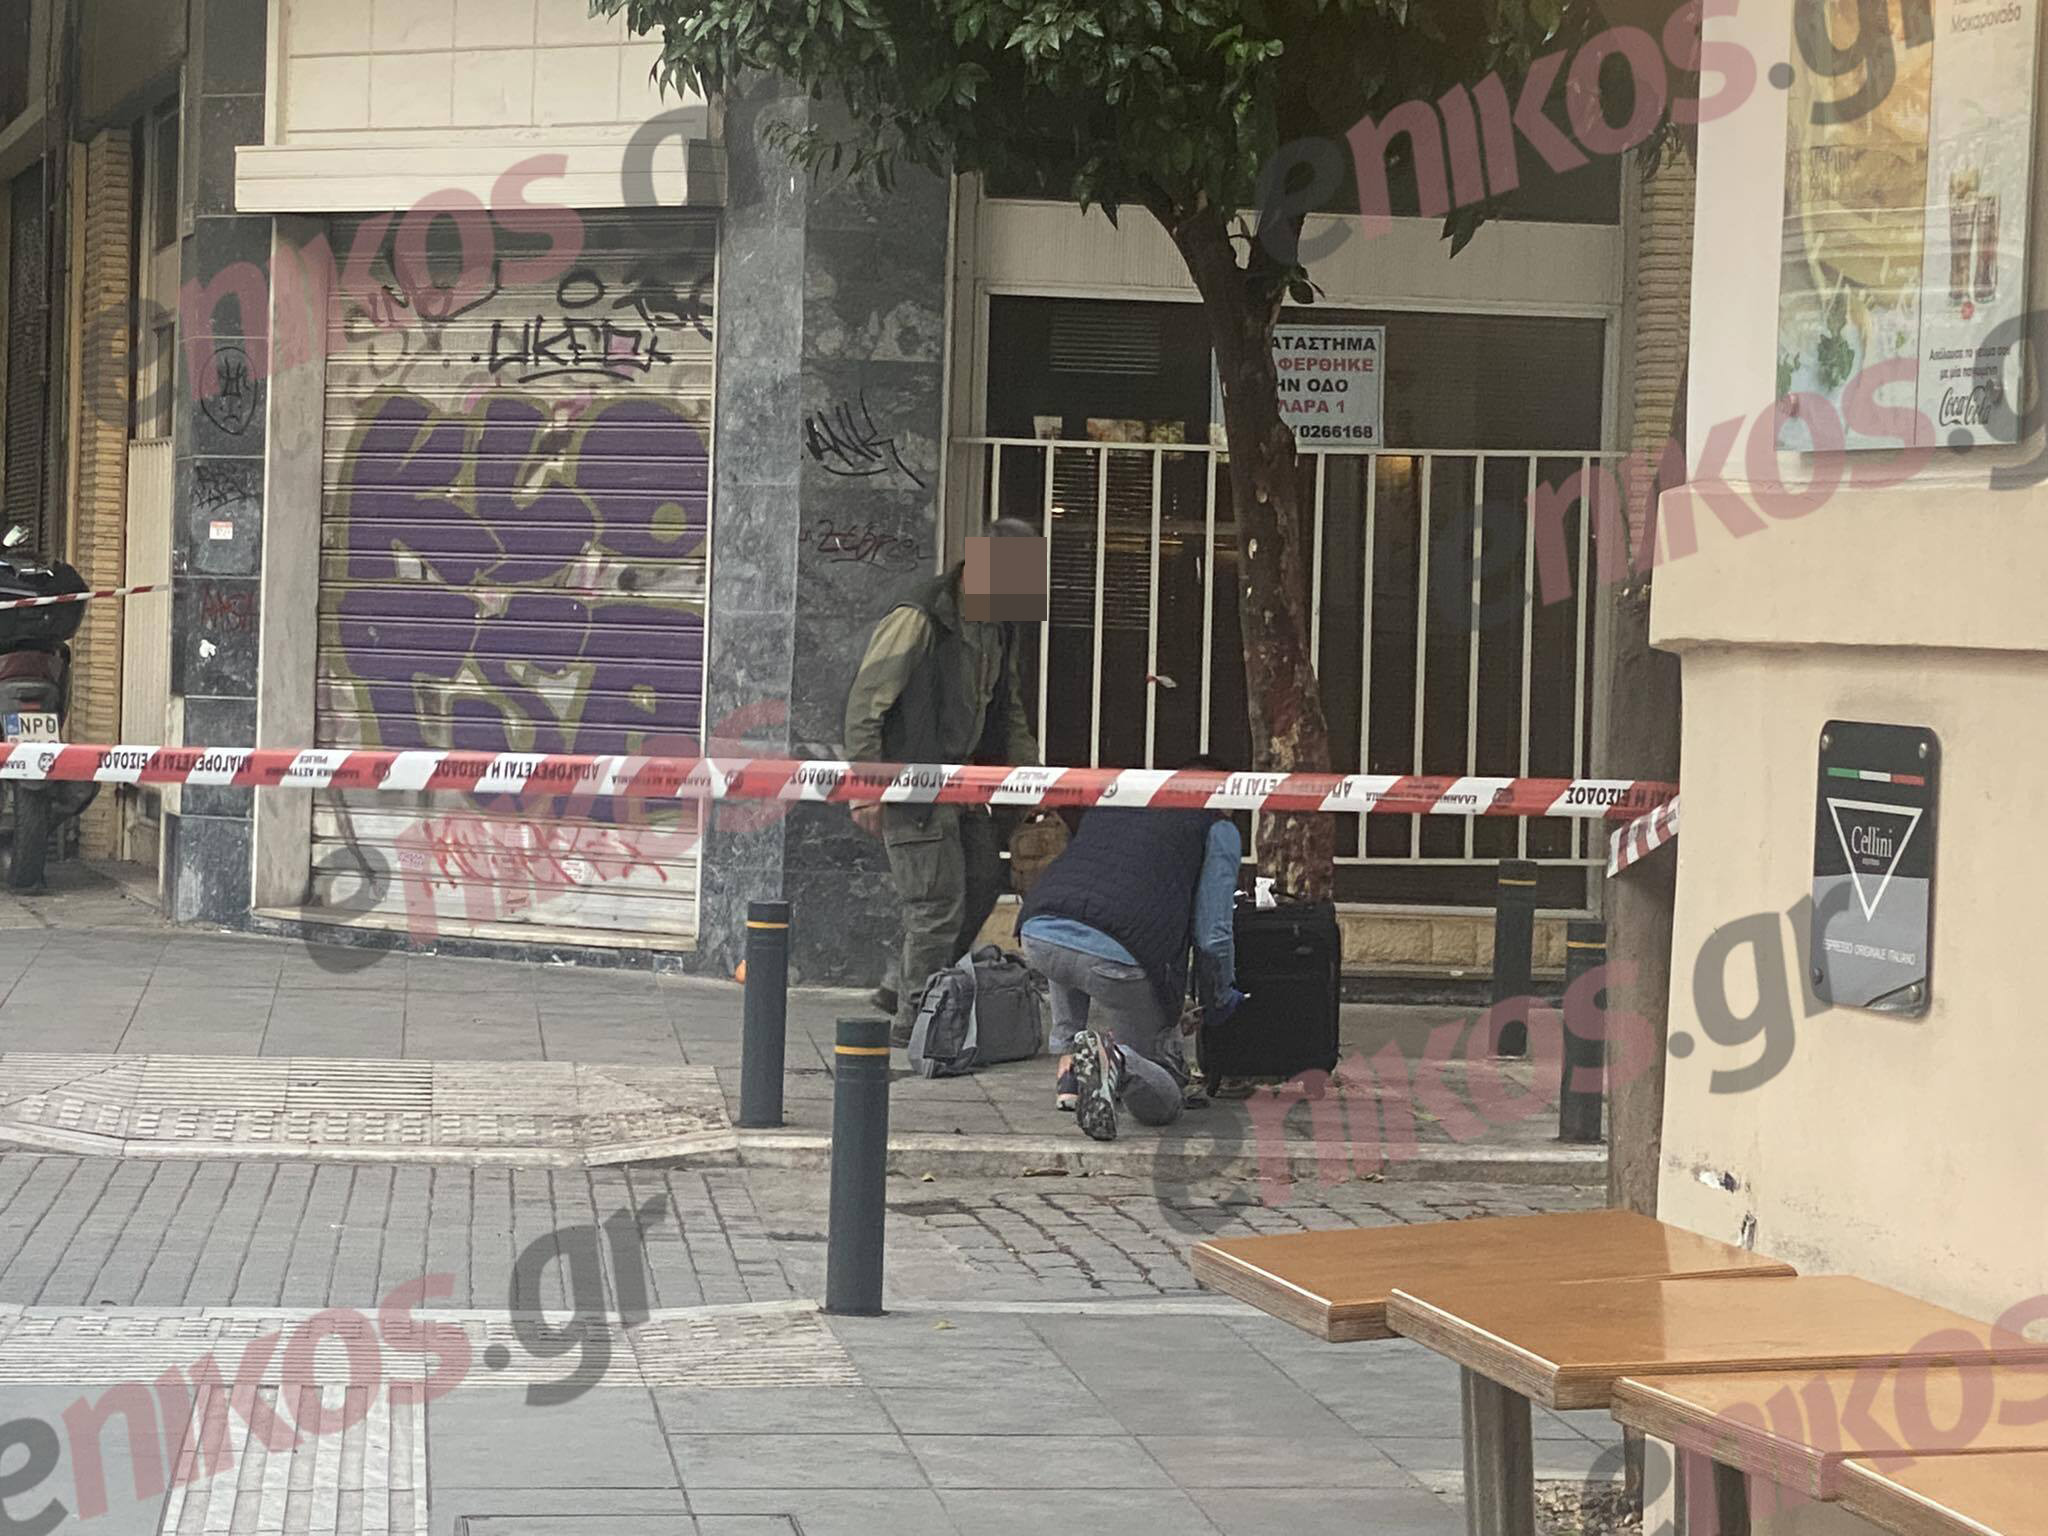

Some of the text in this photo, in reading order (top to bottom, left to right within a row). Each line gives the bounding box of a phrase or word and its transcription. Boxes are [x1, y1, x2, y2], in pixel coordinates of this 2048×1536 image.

[1272, 336, 1376, 350] ΑΤΑΣΤΗΜΑ
[1278, 357, 1374, 372] ΦΕΡΘΗΚΕ
[1307, 378, 1349, 392] ΟΔΟ
[1336, 400, 1345, 413] 1
[1566, 787, 1631, 806] ΕΙΣΟΔΟΣ
[1851, 826, 1893, 858] Cellini
